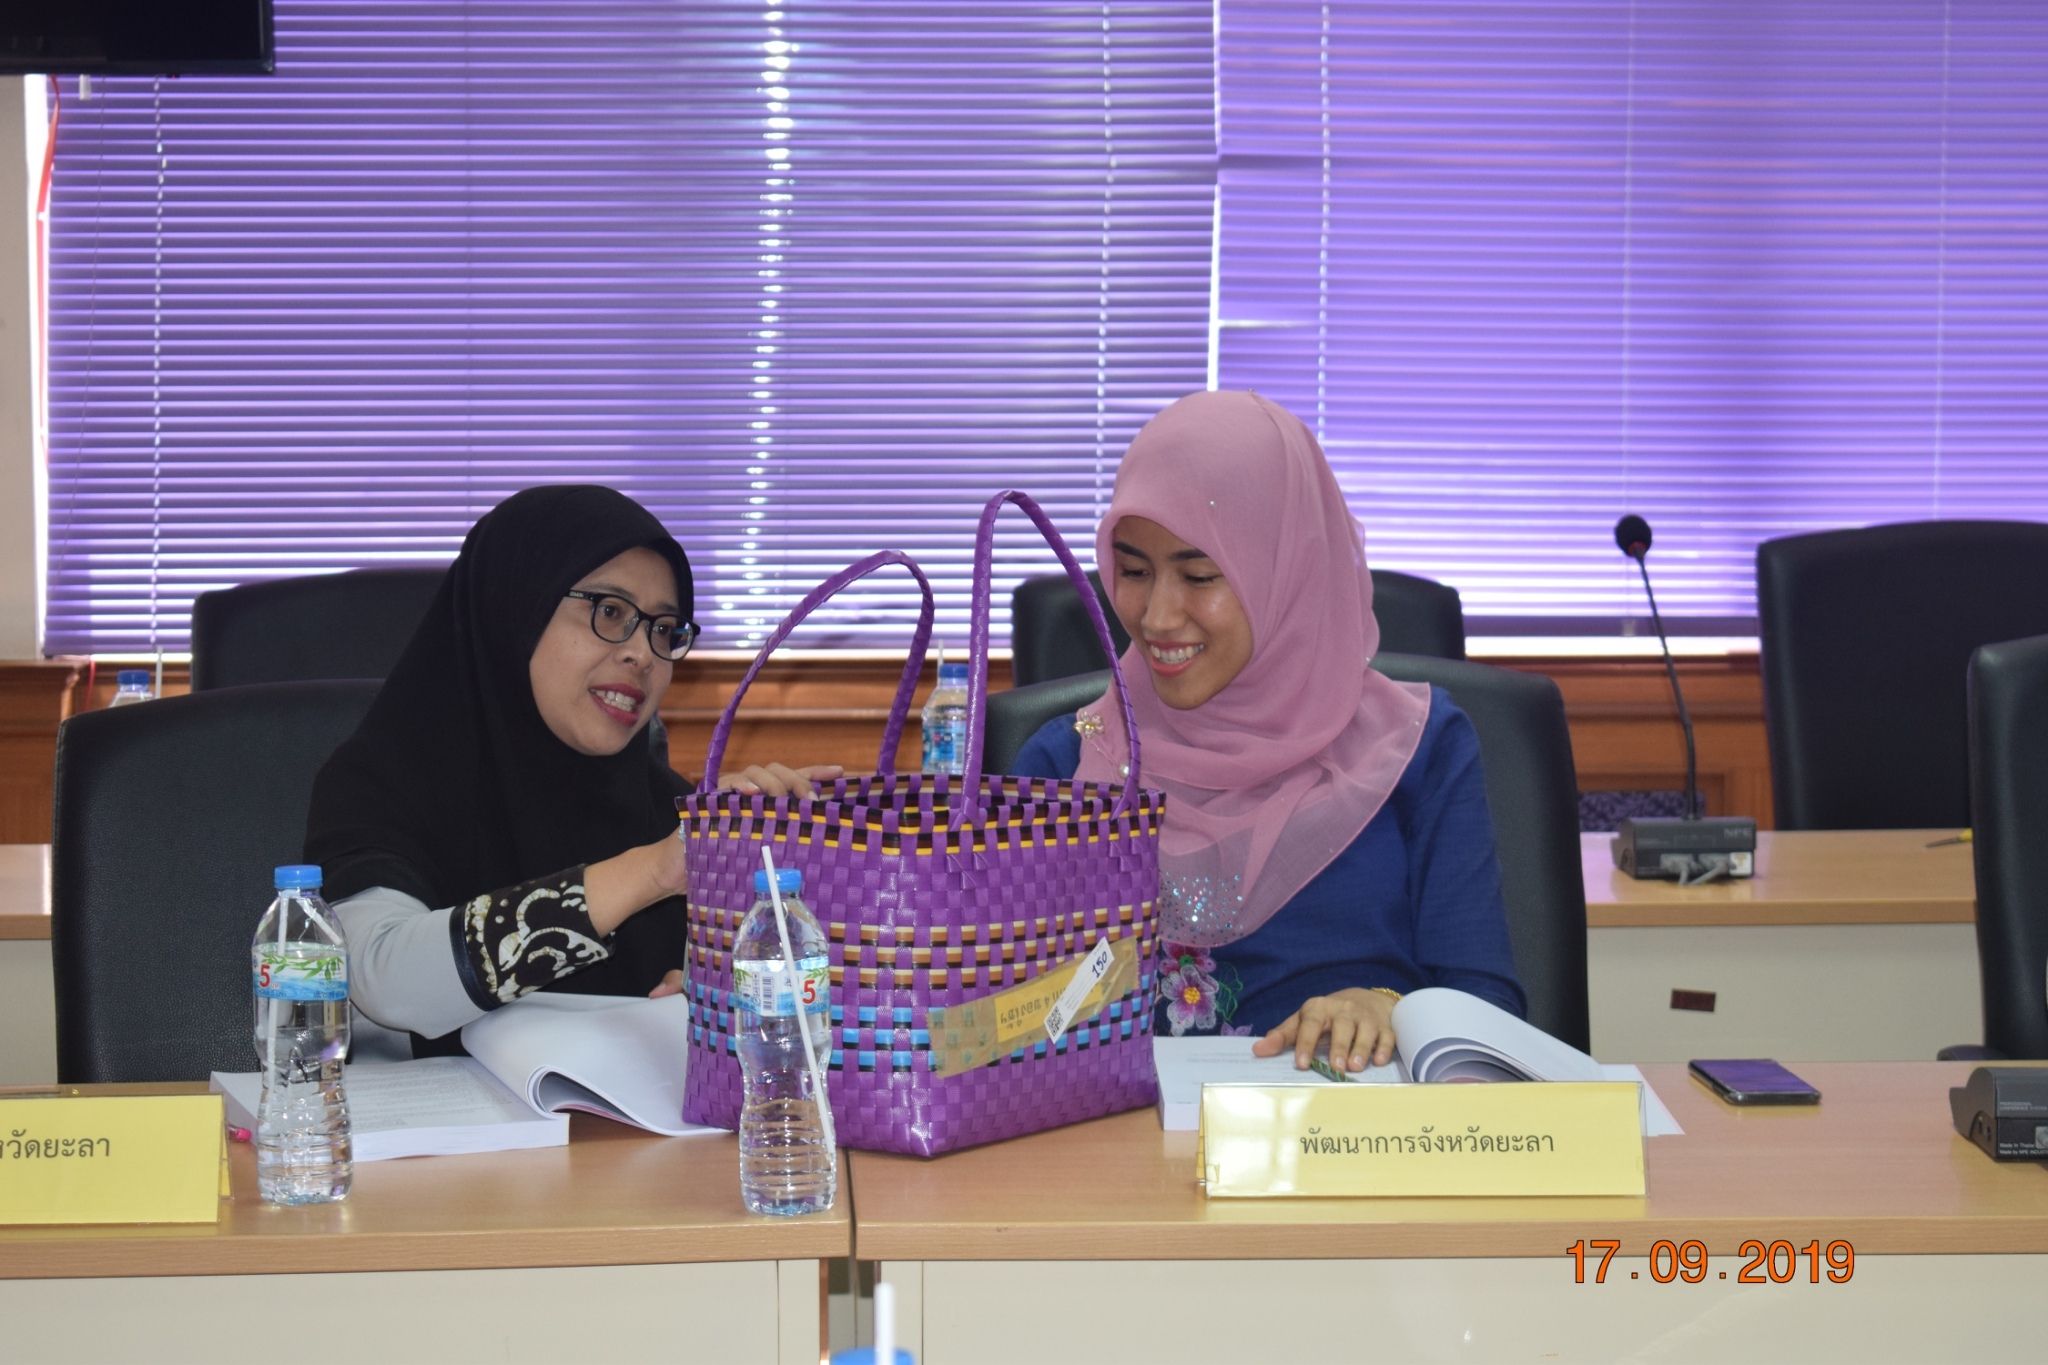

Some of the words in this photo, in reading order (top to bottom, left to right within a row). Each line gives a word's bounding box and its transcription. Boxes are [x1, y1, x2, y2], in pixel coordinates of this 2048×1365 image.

[259, 964, 271, 988] 5
[1092, 951, 1108, 979] 150
[802, 979, 816, 1004] 5
[1299, 1126, 1555, 1155] พัฒนาการจังหวัดยะลา
